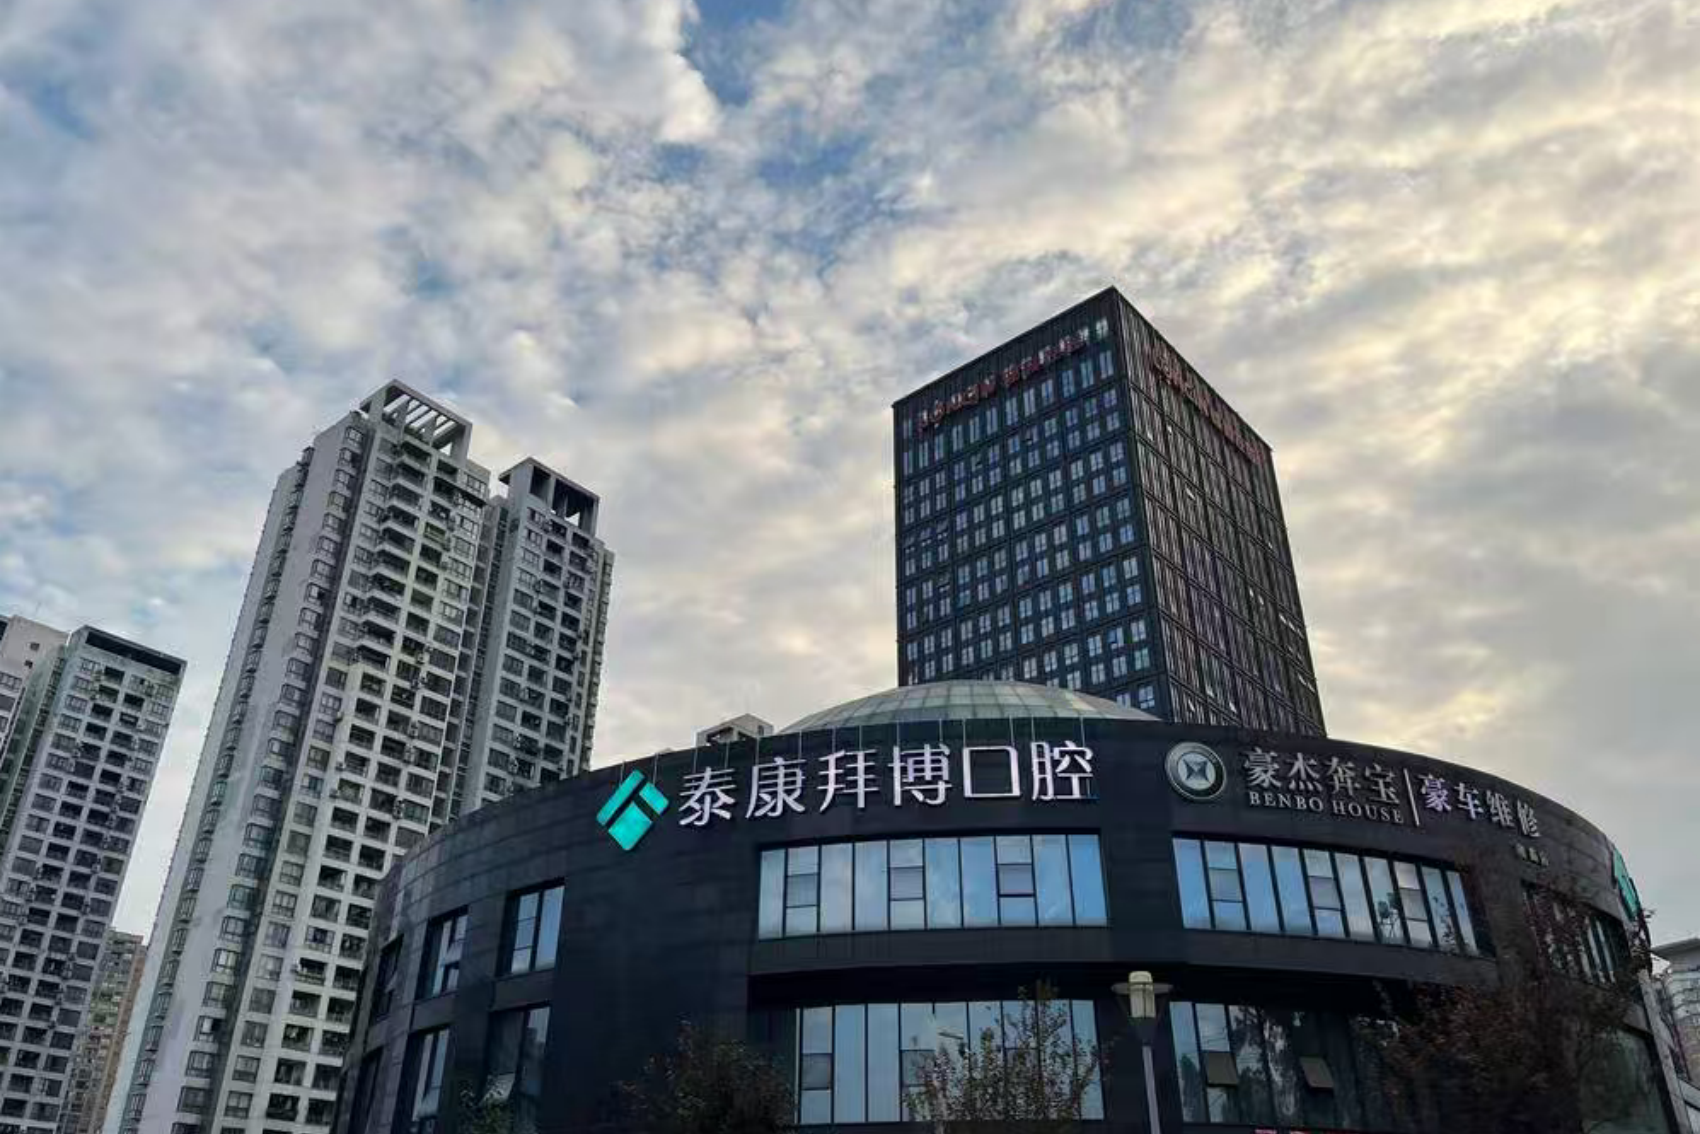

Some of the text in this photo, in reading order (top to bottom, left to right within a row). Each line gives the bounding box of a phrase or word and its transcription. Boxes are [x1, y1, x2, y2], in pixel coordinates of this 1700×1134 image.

[678, 740, 1094, 827] 泰康拜博口腔
[1243, 747, 1400, 804] 豪杰奔宝
[1249, 790, 1404, 824] BENBO HOUSE
[1418, 774, 1541, 838] 豪车维修
